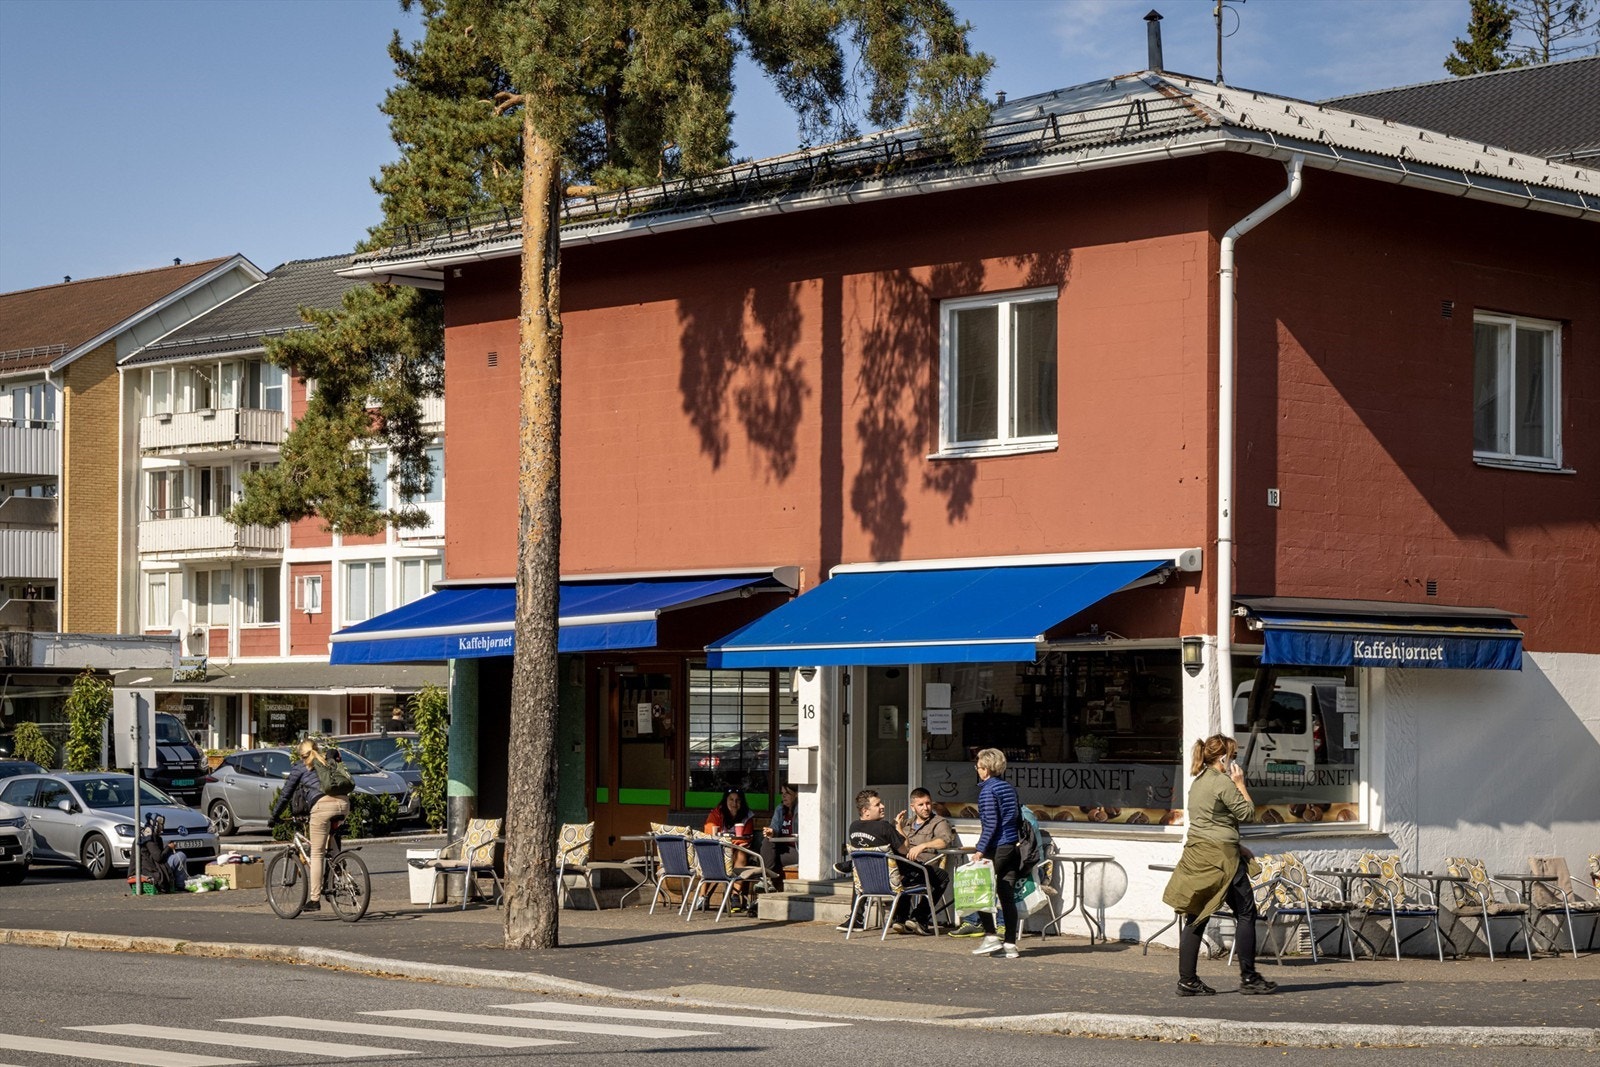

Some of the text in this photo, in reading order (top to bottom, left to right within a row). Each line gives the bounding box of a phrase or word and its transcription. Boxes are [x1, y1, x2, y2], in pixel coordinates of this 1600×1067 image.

[1270, 491, 1278, 504] 18
[459, 636, 512, 651] Kaffehjørnet
[1353, 640, 1444, 663] Kaffehjørnet
[802, 704, 815, 719] 18
